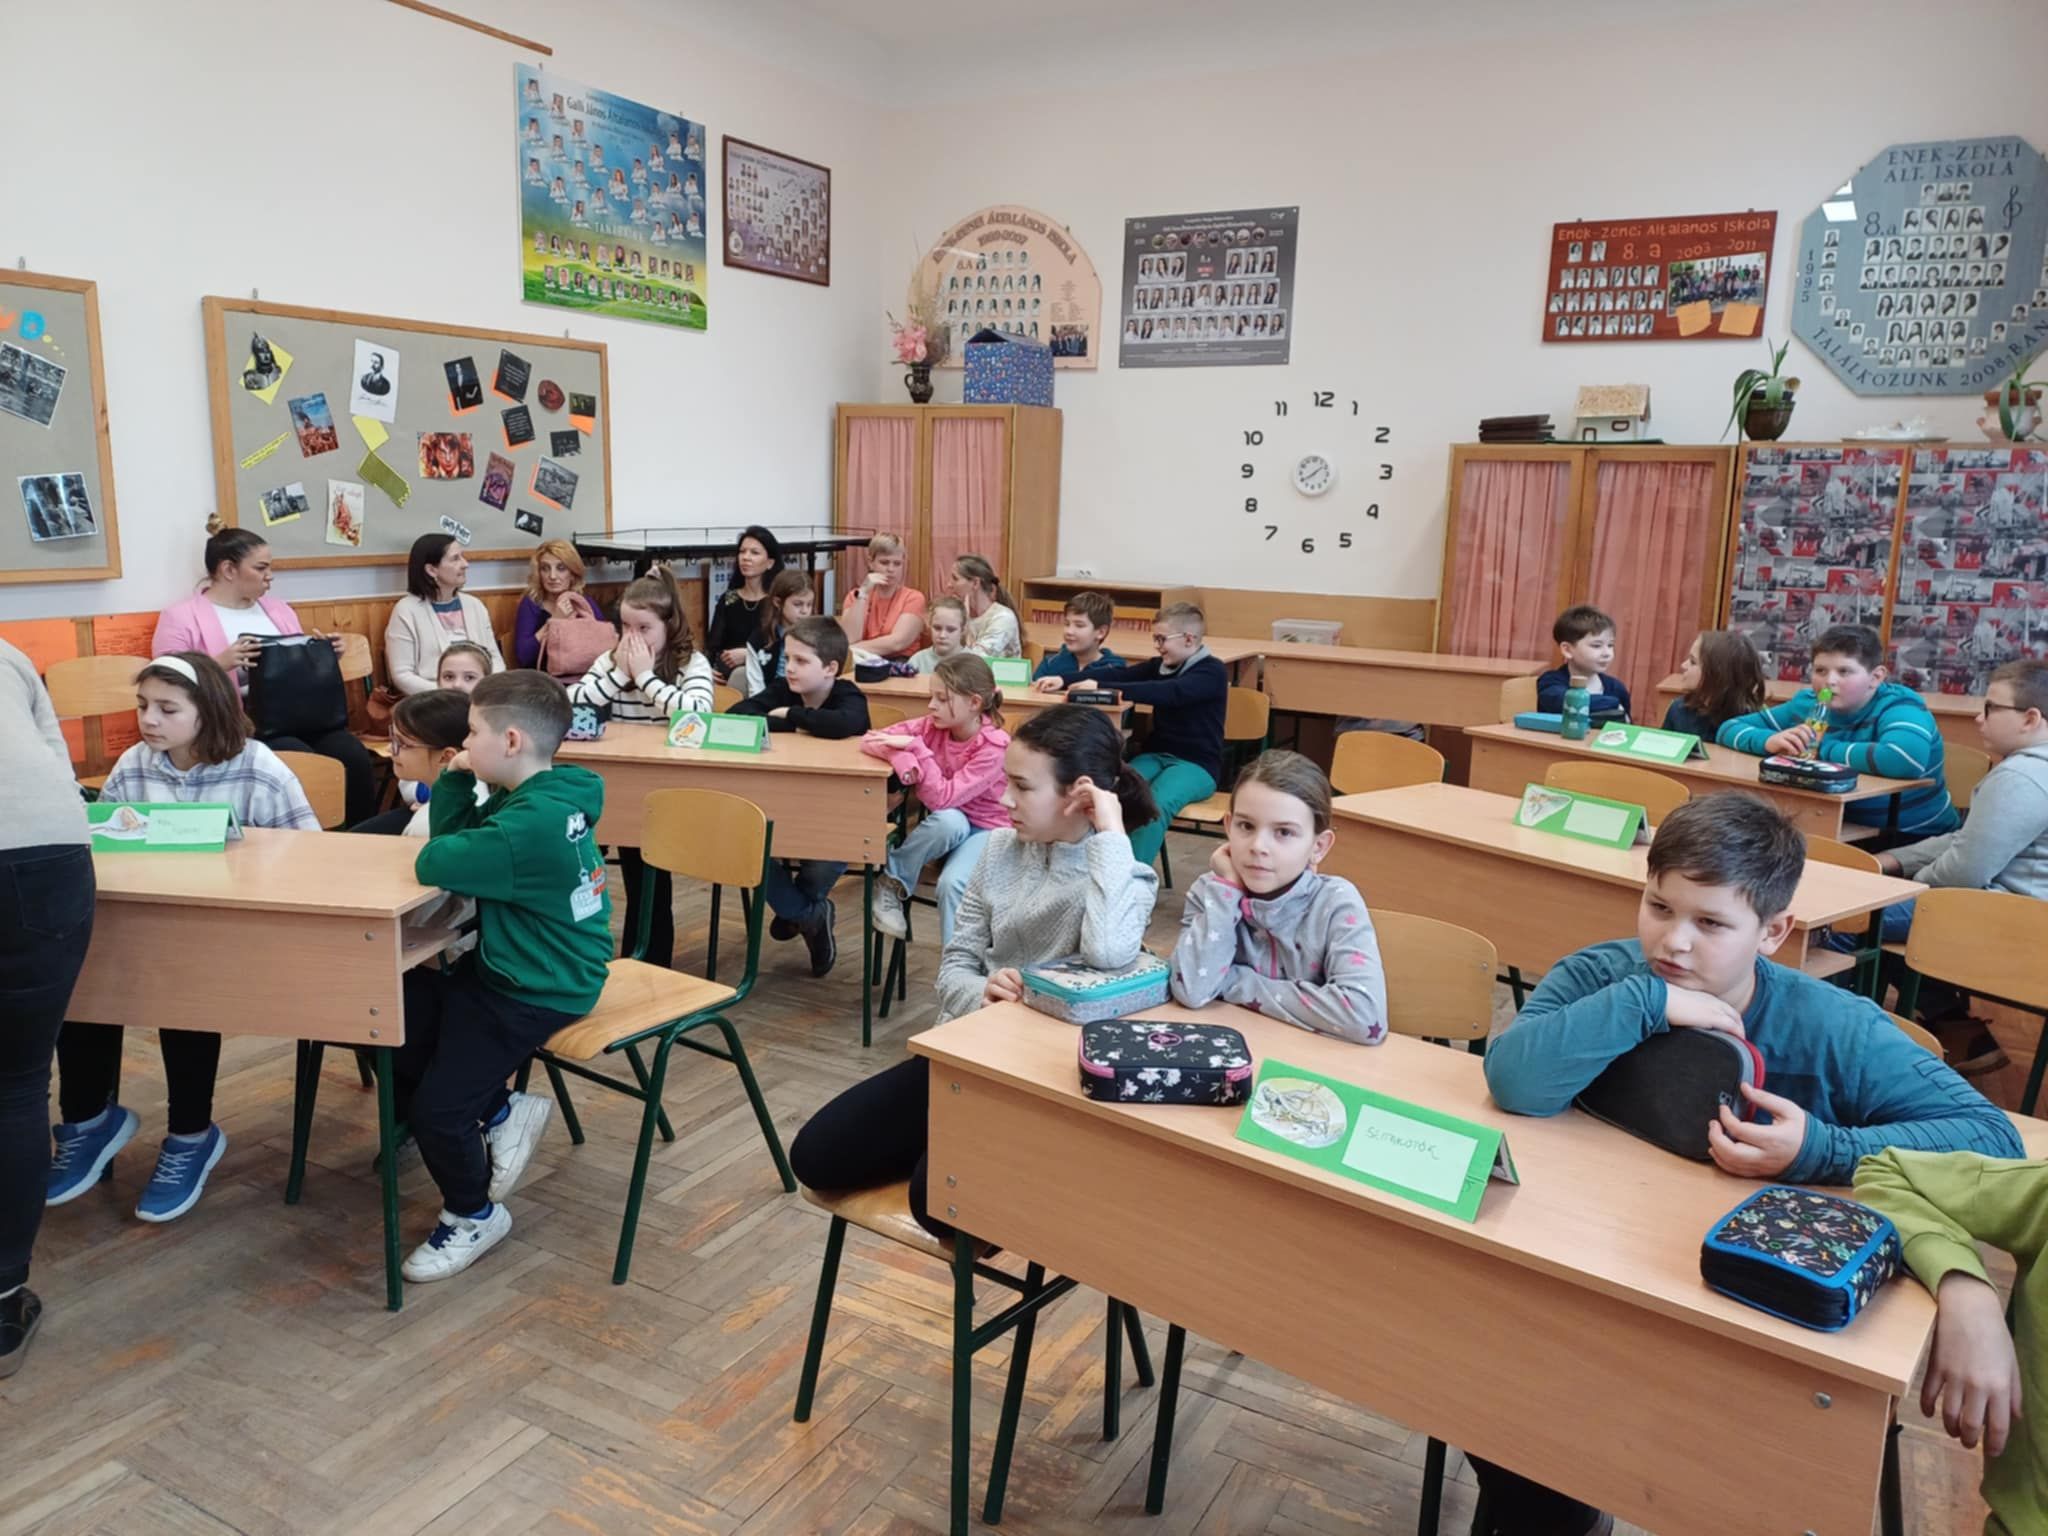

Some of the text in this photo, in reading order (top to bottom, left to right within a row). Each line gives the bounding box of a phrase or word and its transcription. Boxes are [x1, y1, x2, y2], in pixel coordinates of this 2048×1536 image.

[1935, 161, 2014, 180] ISKOLA
[1313, 391, 1335, 408] 12
[1275, 401, 1288, 417] 11
[1352, 400, 1359, 416] 1
[1244, 430, 1264, 446] 10
[1374, 427, 1391, 443] 2
[1241, 463, 1254, 479] 9
[1379, 464, 1393, 480] 3
[1245, 498, 1258, 513] 8
[1366, 504, 1379, 520] 4
[1264, 525, 1278, 541] 7
[1339, 532, 1353, 548] 5
[1301, 538, 1315, 553] 6
